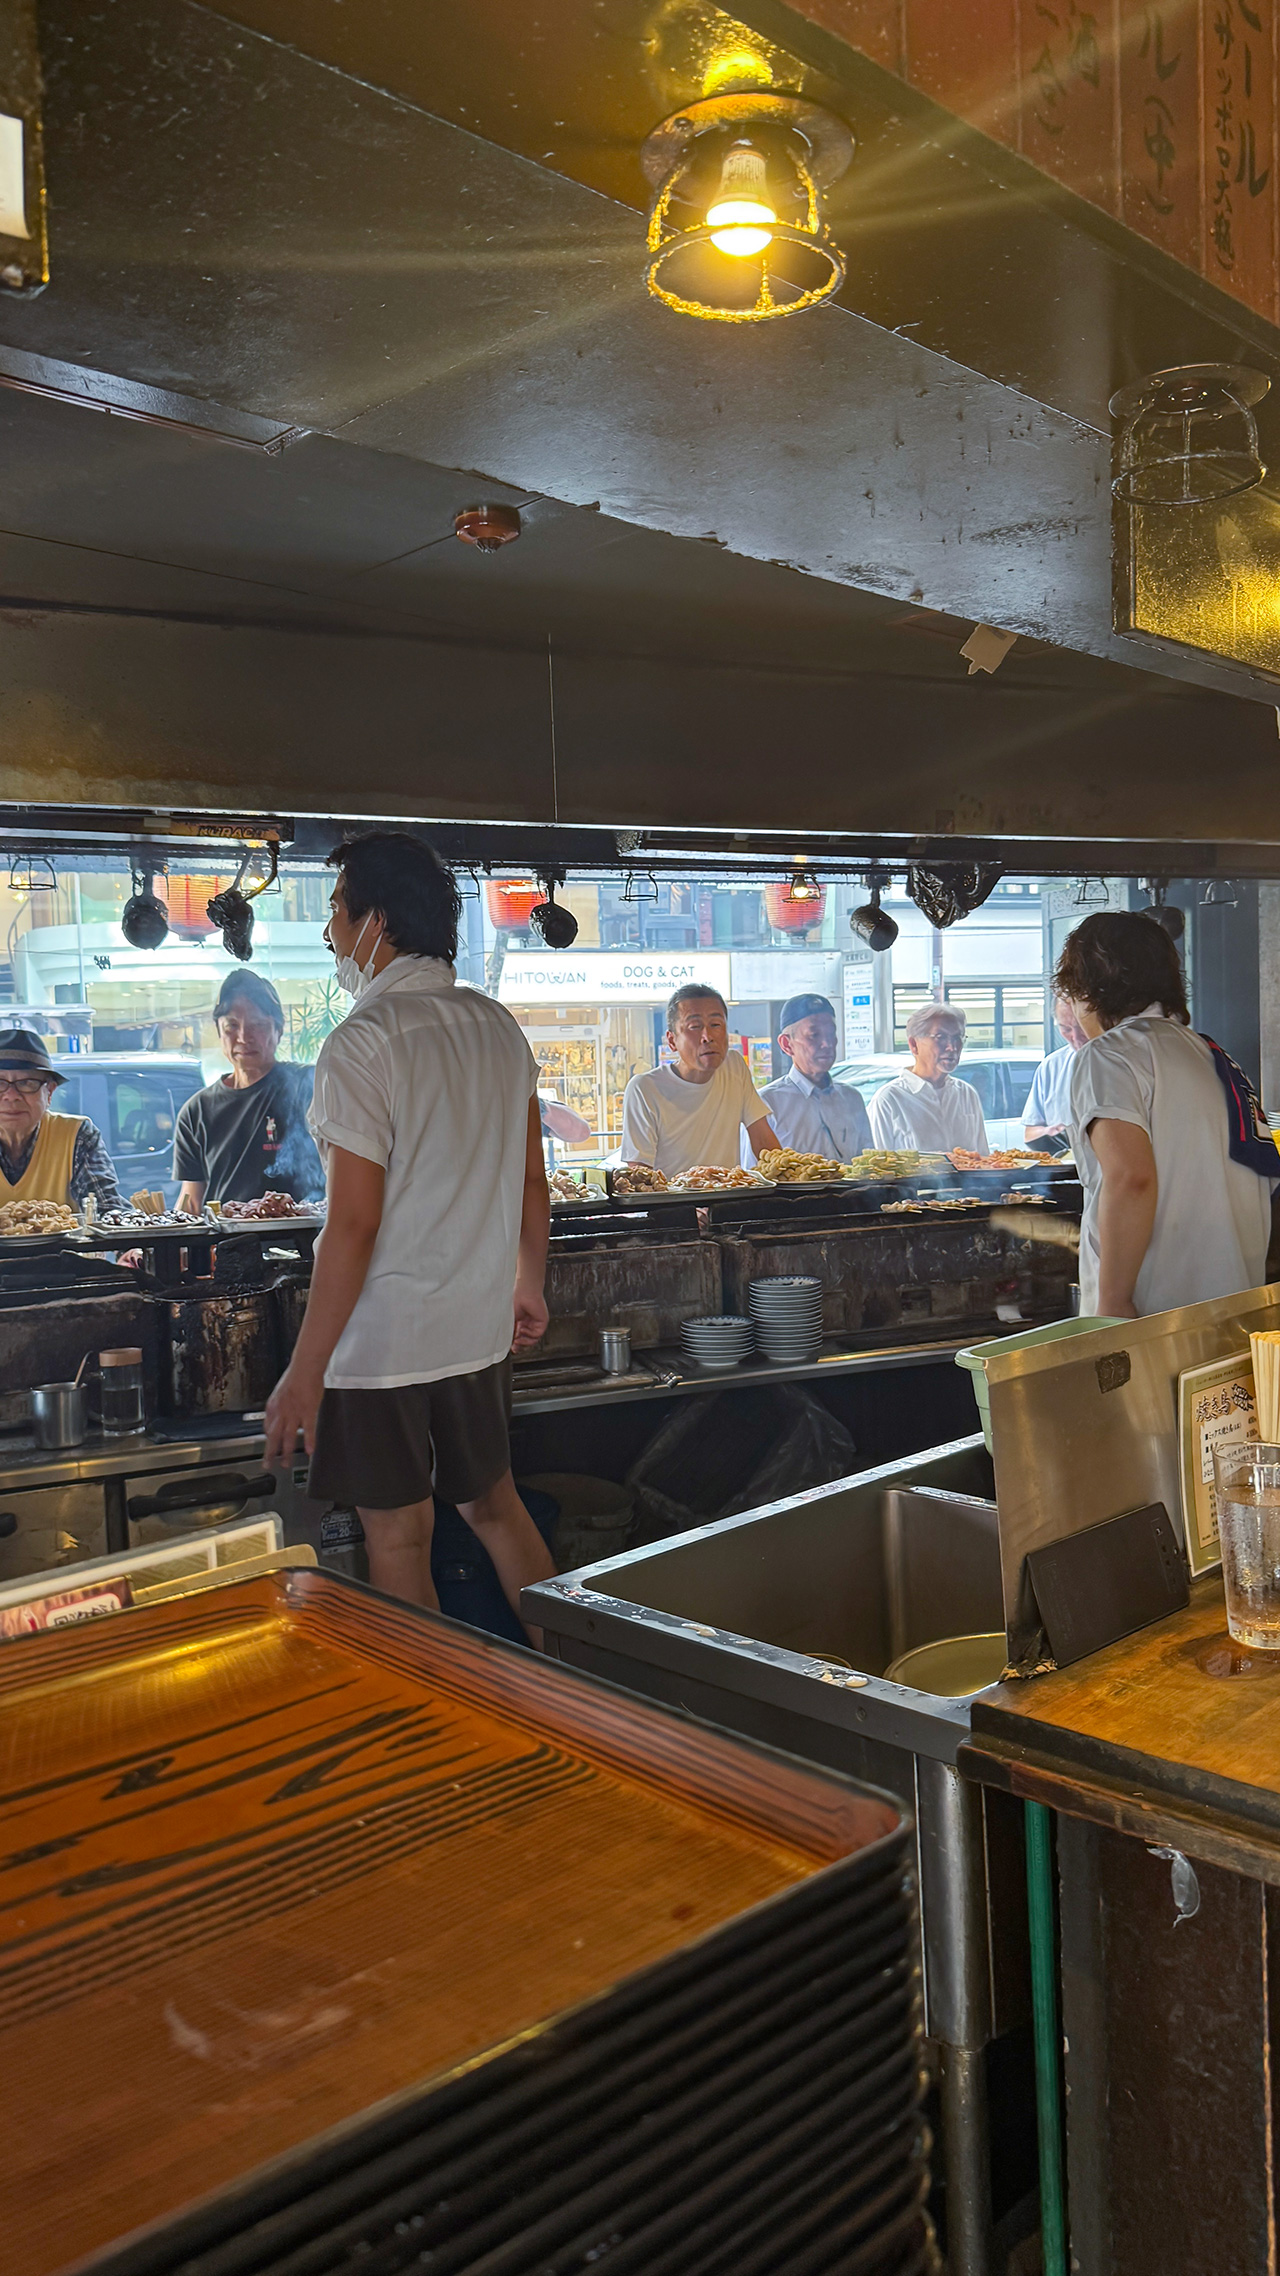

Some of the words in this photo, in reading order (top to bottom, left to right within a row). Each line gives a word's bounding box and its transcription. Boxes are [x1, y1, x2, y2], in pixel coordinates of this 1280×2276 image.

[504, 972, 586, 984] HITOWAN
[623, 966, 653, 978] DOG
[657, 966, 667, 978] &
[670, 966, 695, 978] CAT
[600, 980, 625, 989] foods,
[627, 980, 651, 989] treats,
[653, 980, 677, 990] goods,
